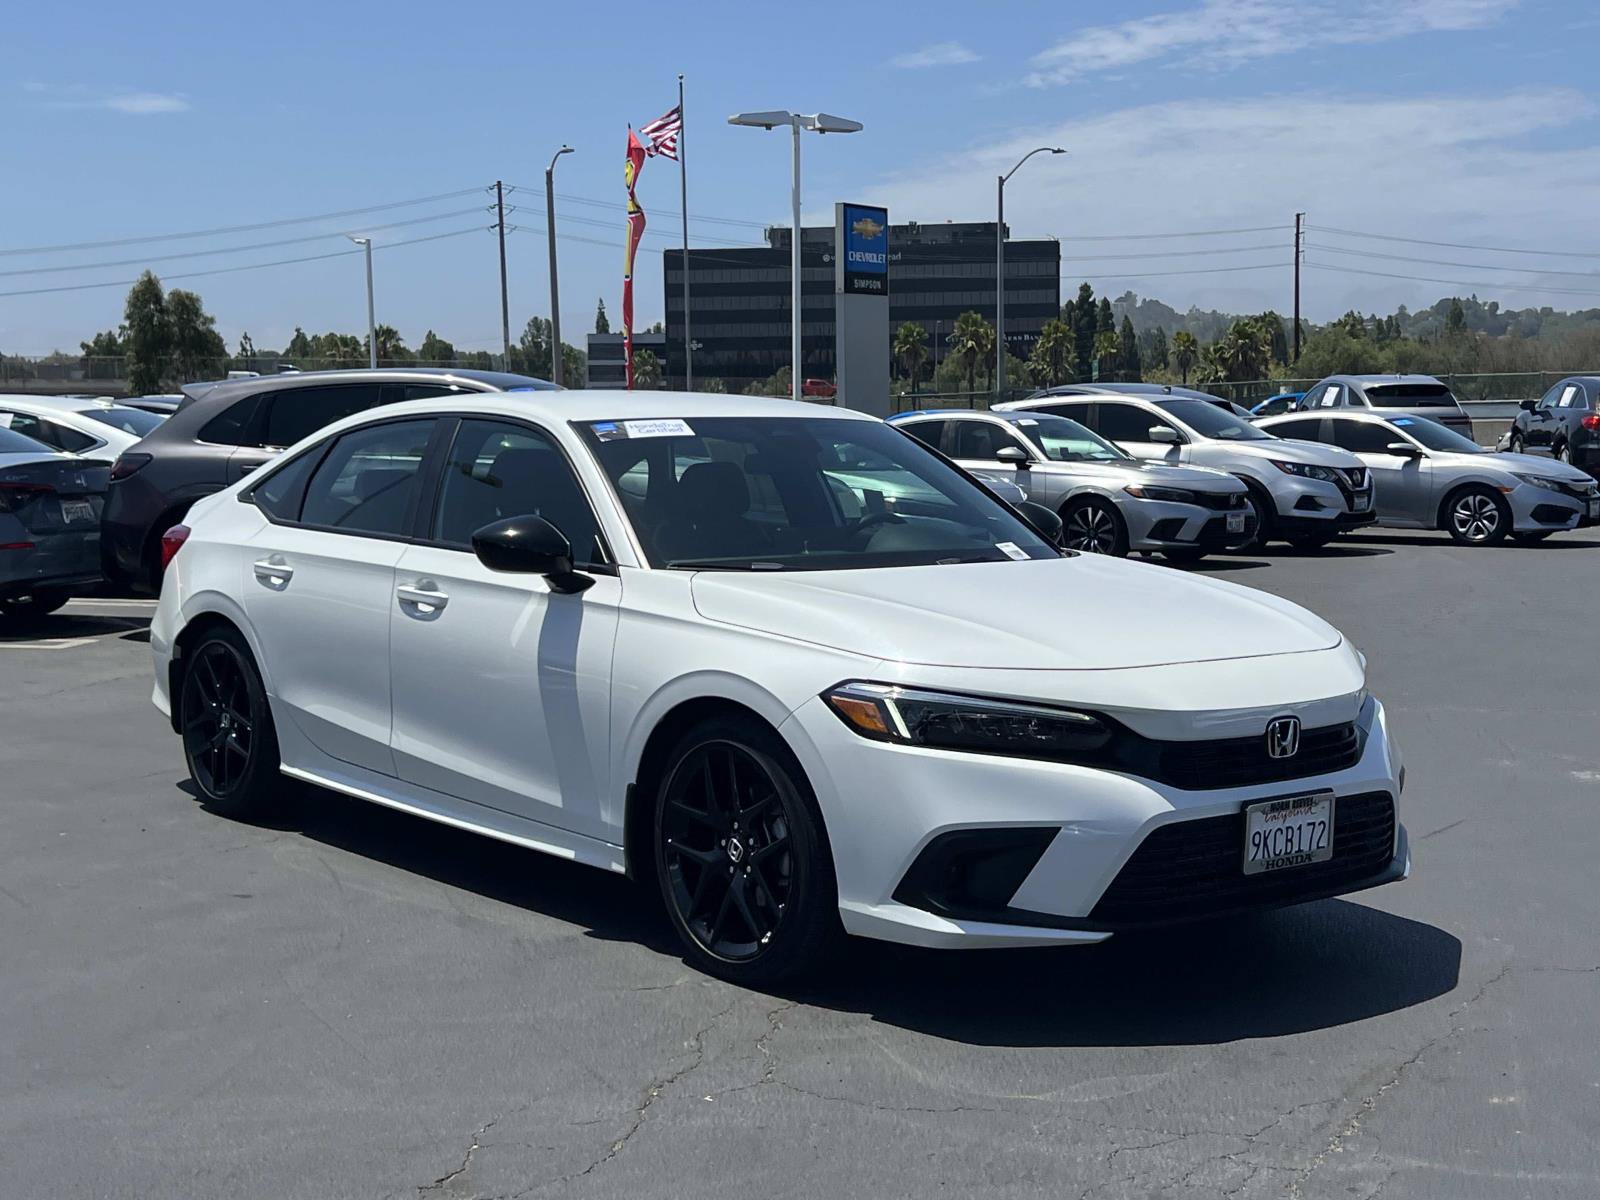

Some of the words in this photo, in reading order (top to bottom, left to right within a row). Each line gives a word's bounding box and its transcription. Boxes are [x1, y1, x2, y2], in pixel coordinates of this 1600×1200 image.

[848, 251, 886, 263] CHEVROLET
[853, 279, 882, 289] SIMPSON
[1263, 805, 1317, 824] California
[1250, 820, 1327, 862] 9KCB172
[1264, 853, 1313, 870] HONDA
